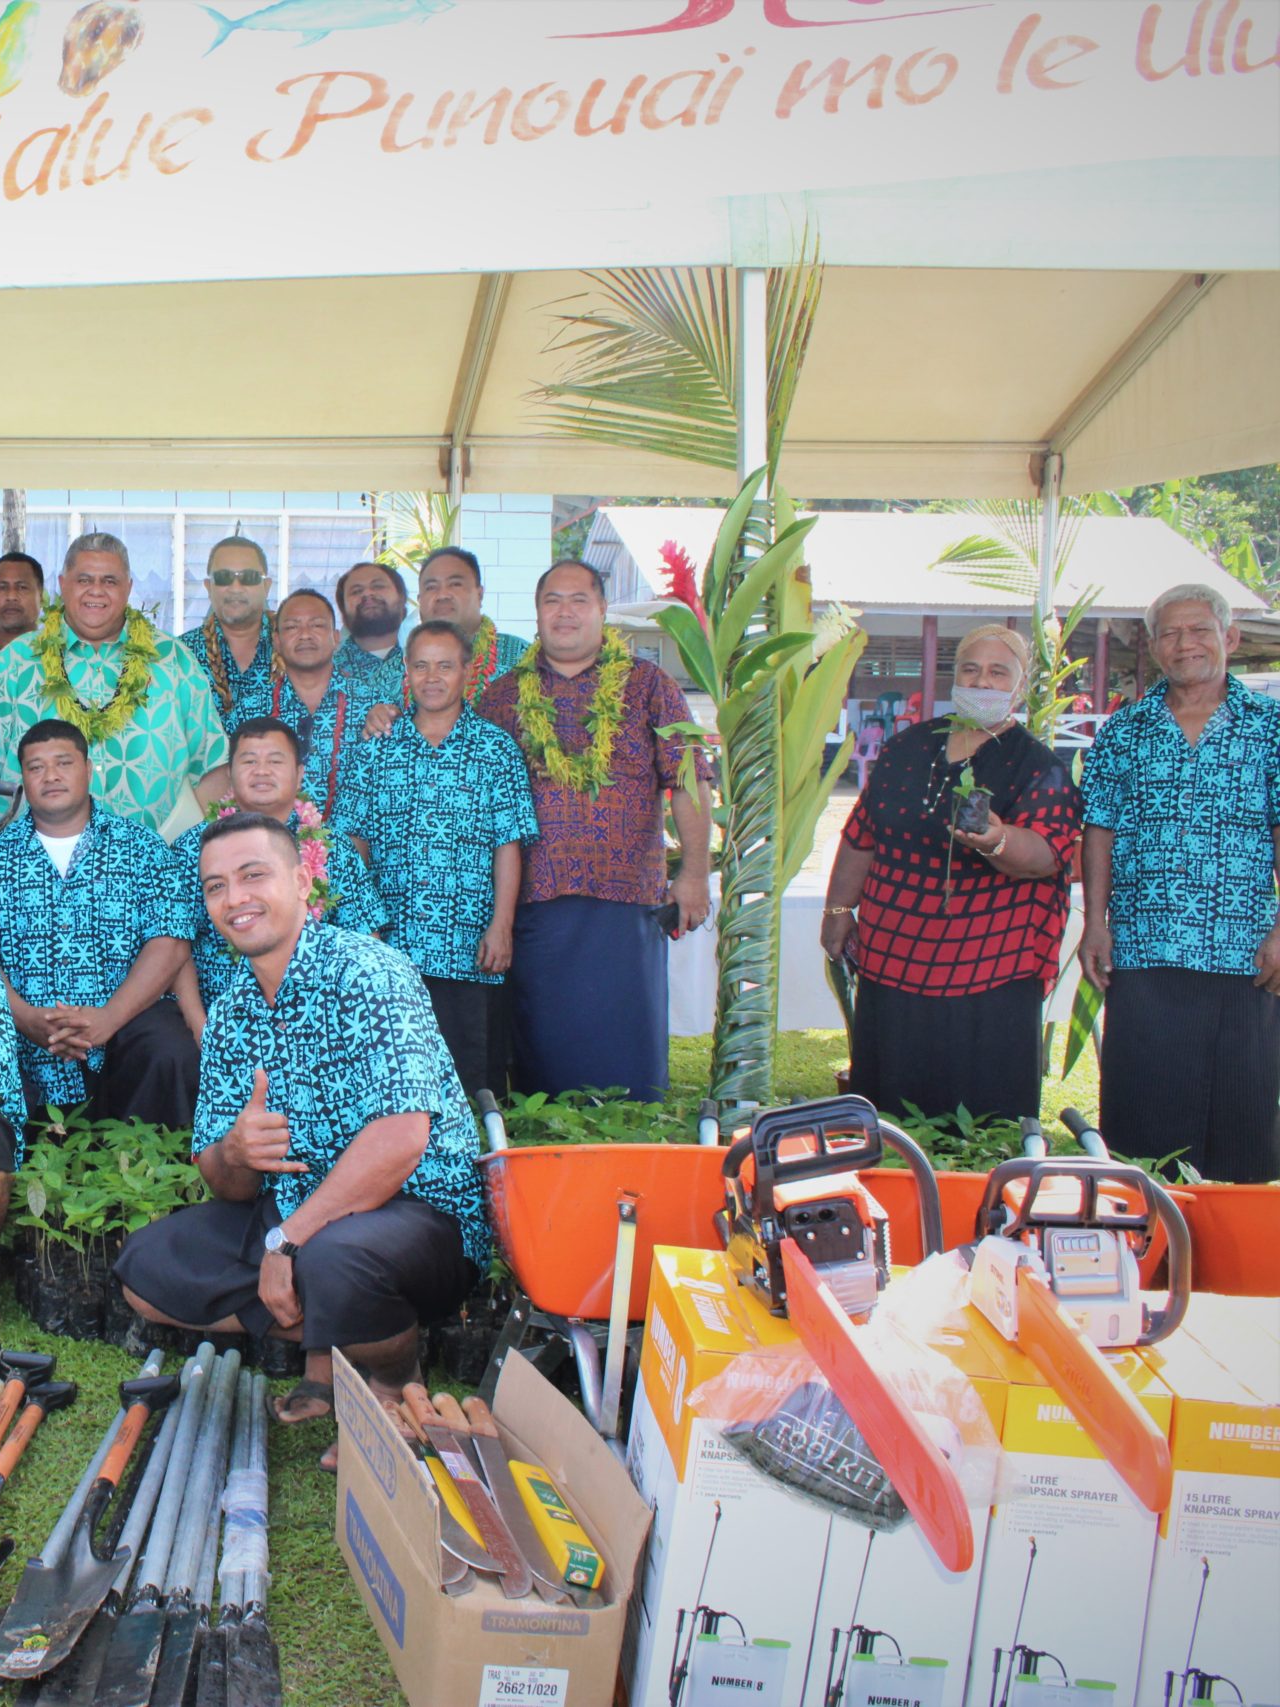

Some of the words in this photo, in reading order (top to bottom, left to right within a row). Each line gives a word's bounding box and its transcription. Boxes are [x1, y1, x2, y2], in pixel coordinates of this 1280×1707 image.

[775, 46, 959, 119] mo
[996, 13, 1101, 94] le
[650, 1302, 676, 1377] NUMBER
[673, 1355, 686, 1425] 8
[1037, 1404, 1076, 1422] NUM
[704, 1439, 714, 1449] 15
[778, 1419, 881, 1490] TOOLKIT
[1030, 1475, 1058, 1486] LITRE
[1071, 1489, 1118, 1502] SPRAYER
[1186, 1493, 1198, 1502] 15
[1202, 1494, 1231, 1504] LITRE
[1184, 1504, 1241, 1517] KNAPSACK
[348, 1507, 401, 1628] TRAMONTINA
[489, 1615, 582, 1632] TRAMONTINA
[496, 1681, 558, 1696] 26621/020
[711, 1676, 753, 1689] NUMBER
[756, 1681, 763, 1691] 8
[867, 1695, 911, 1707] NUMBER
